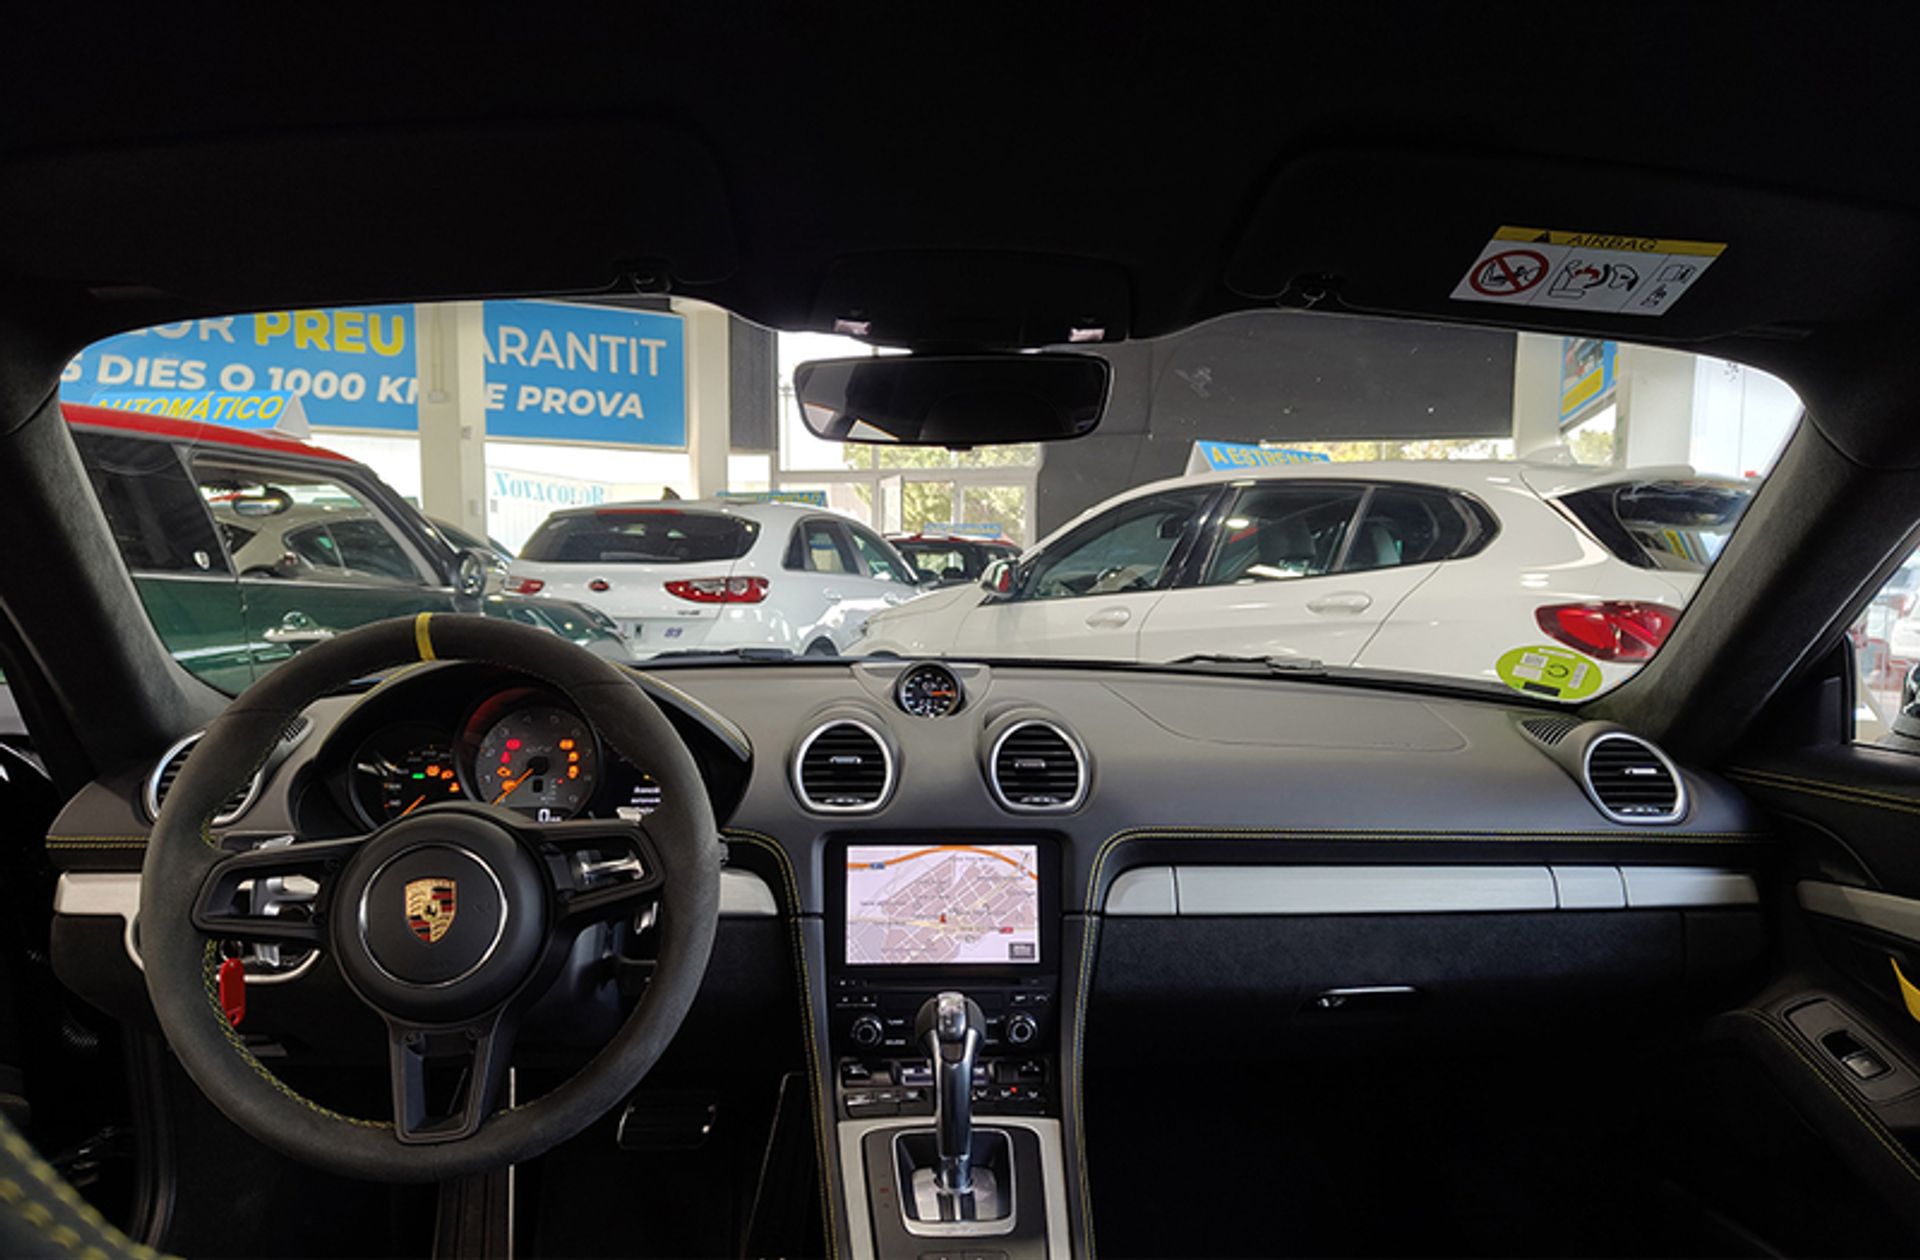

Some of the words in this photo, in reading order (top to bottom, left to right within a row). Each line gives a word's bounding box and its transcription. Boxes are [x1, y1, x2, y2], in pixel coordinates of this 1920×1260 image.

[1567, 234, 1657, 252] AIRBAG
[130, 315, 235, 344] OR
[254, 309, 405, 356] PREU
[97, 354, 207, 391] DIES
[219, 363, 256, 393] O
[267, 366, 367, 402] 1000
[516, 384, 644, 420] PROVA
